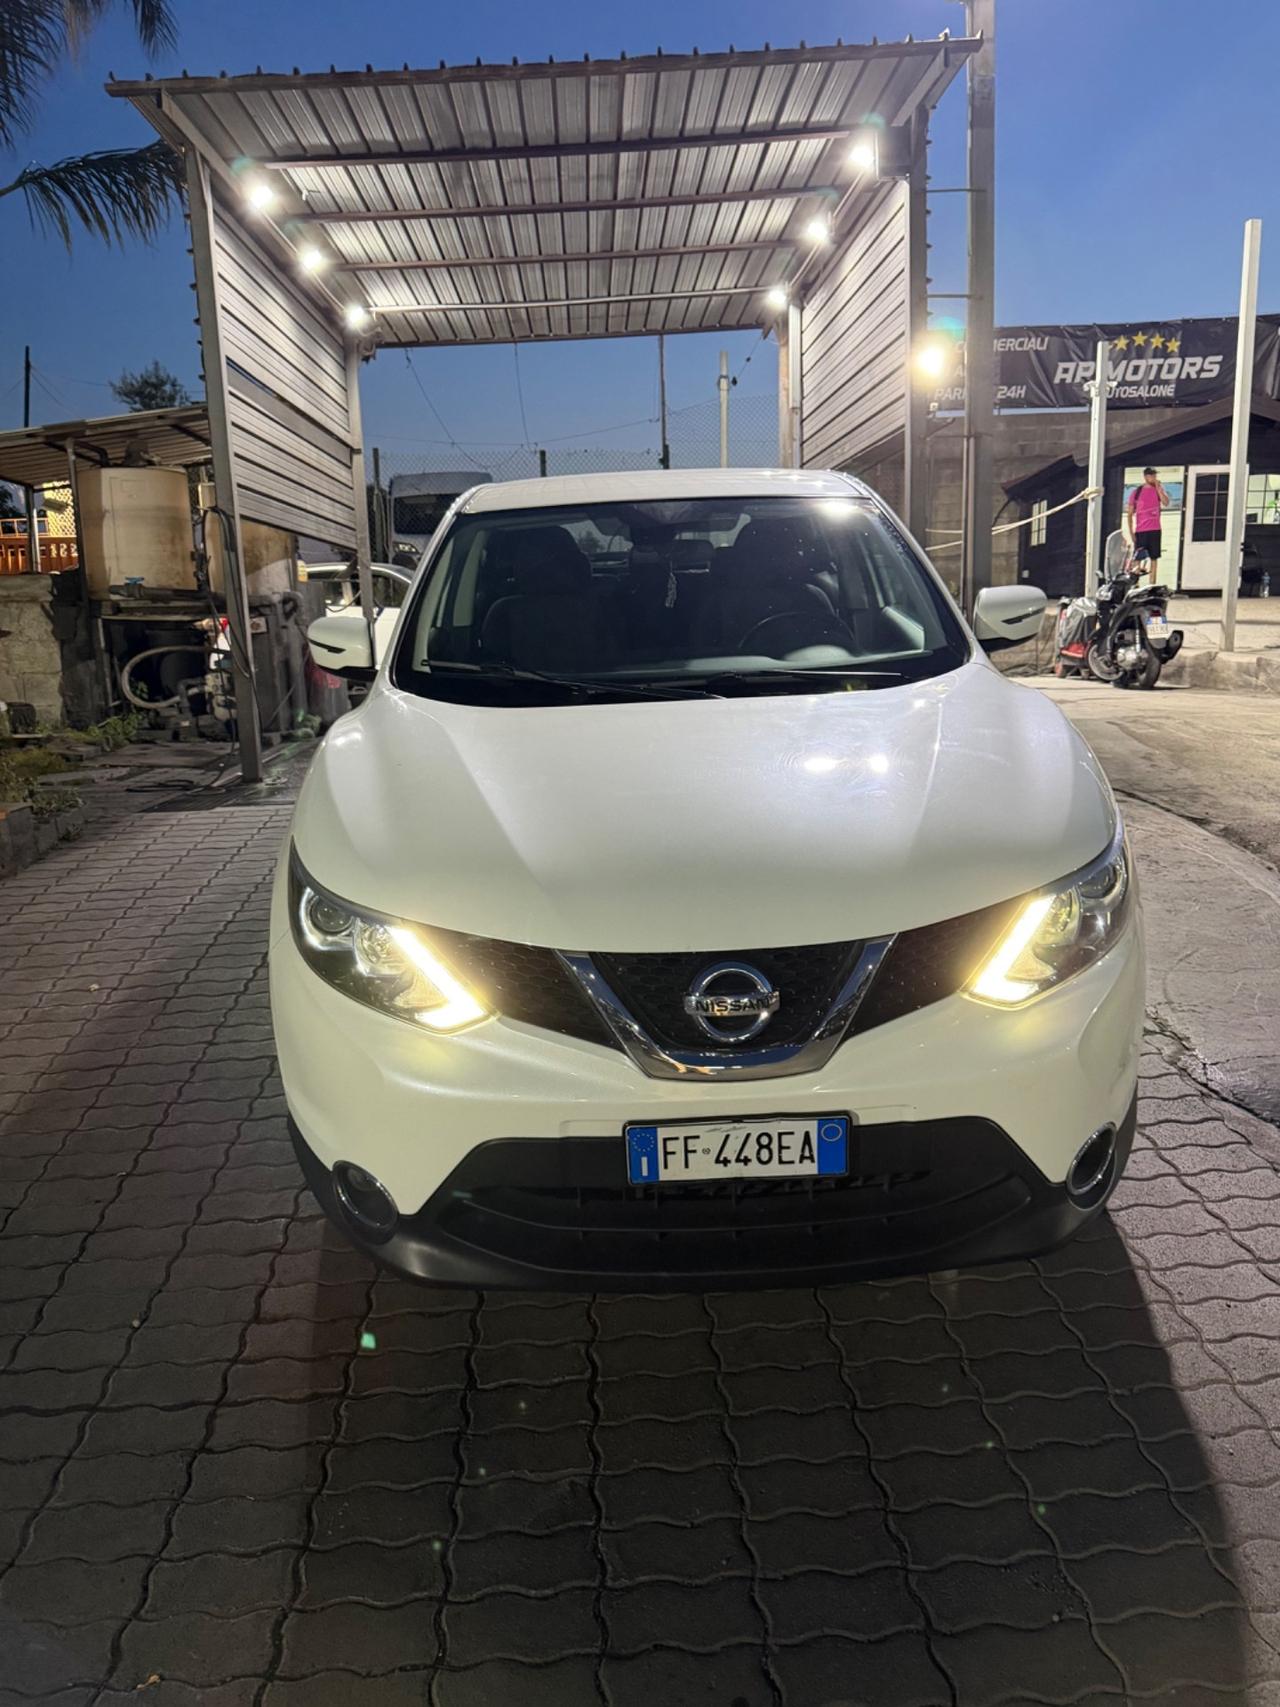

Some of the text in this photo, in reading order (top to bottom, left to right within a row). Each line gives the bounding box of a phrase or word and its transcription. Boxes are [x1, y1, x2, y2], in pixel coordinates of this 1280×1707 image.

[1107, 355, 1223, 382] MOTORS
[997, 385, 1027, 399] 24H
[1105, 384, 1175, 398] UTOSALONE
[695, 997, 770, 1012] NISSAN
[662, 1130, 815, 1169] FF 448EA
